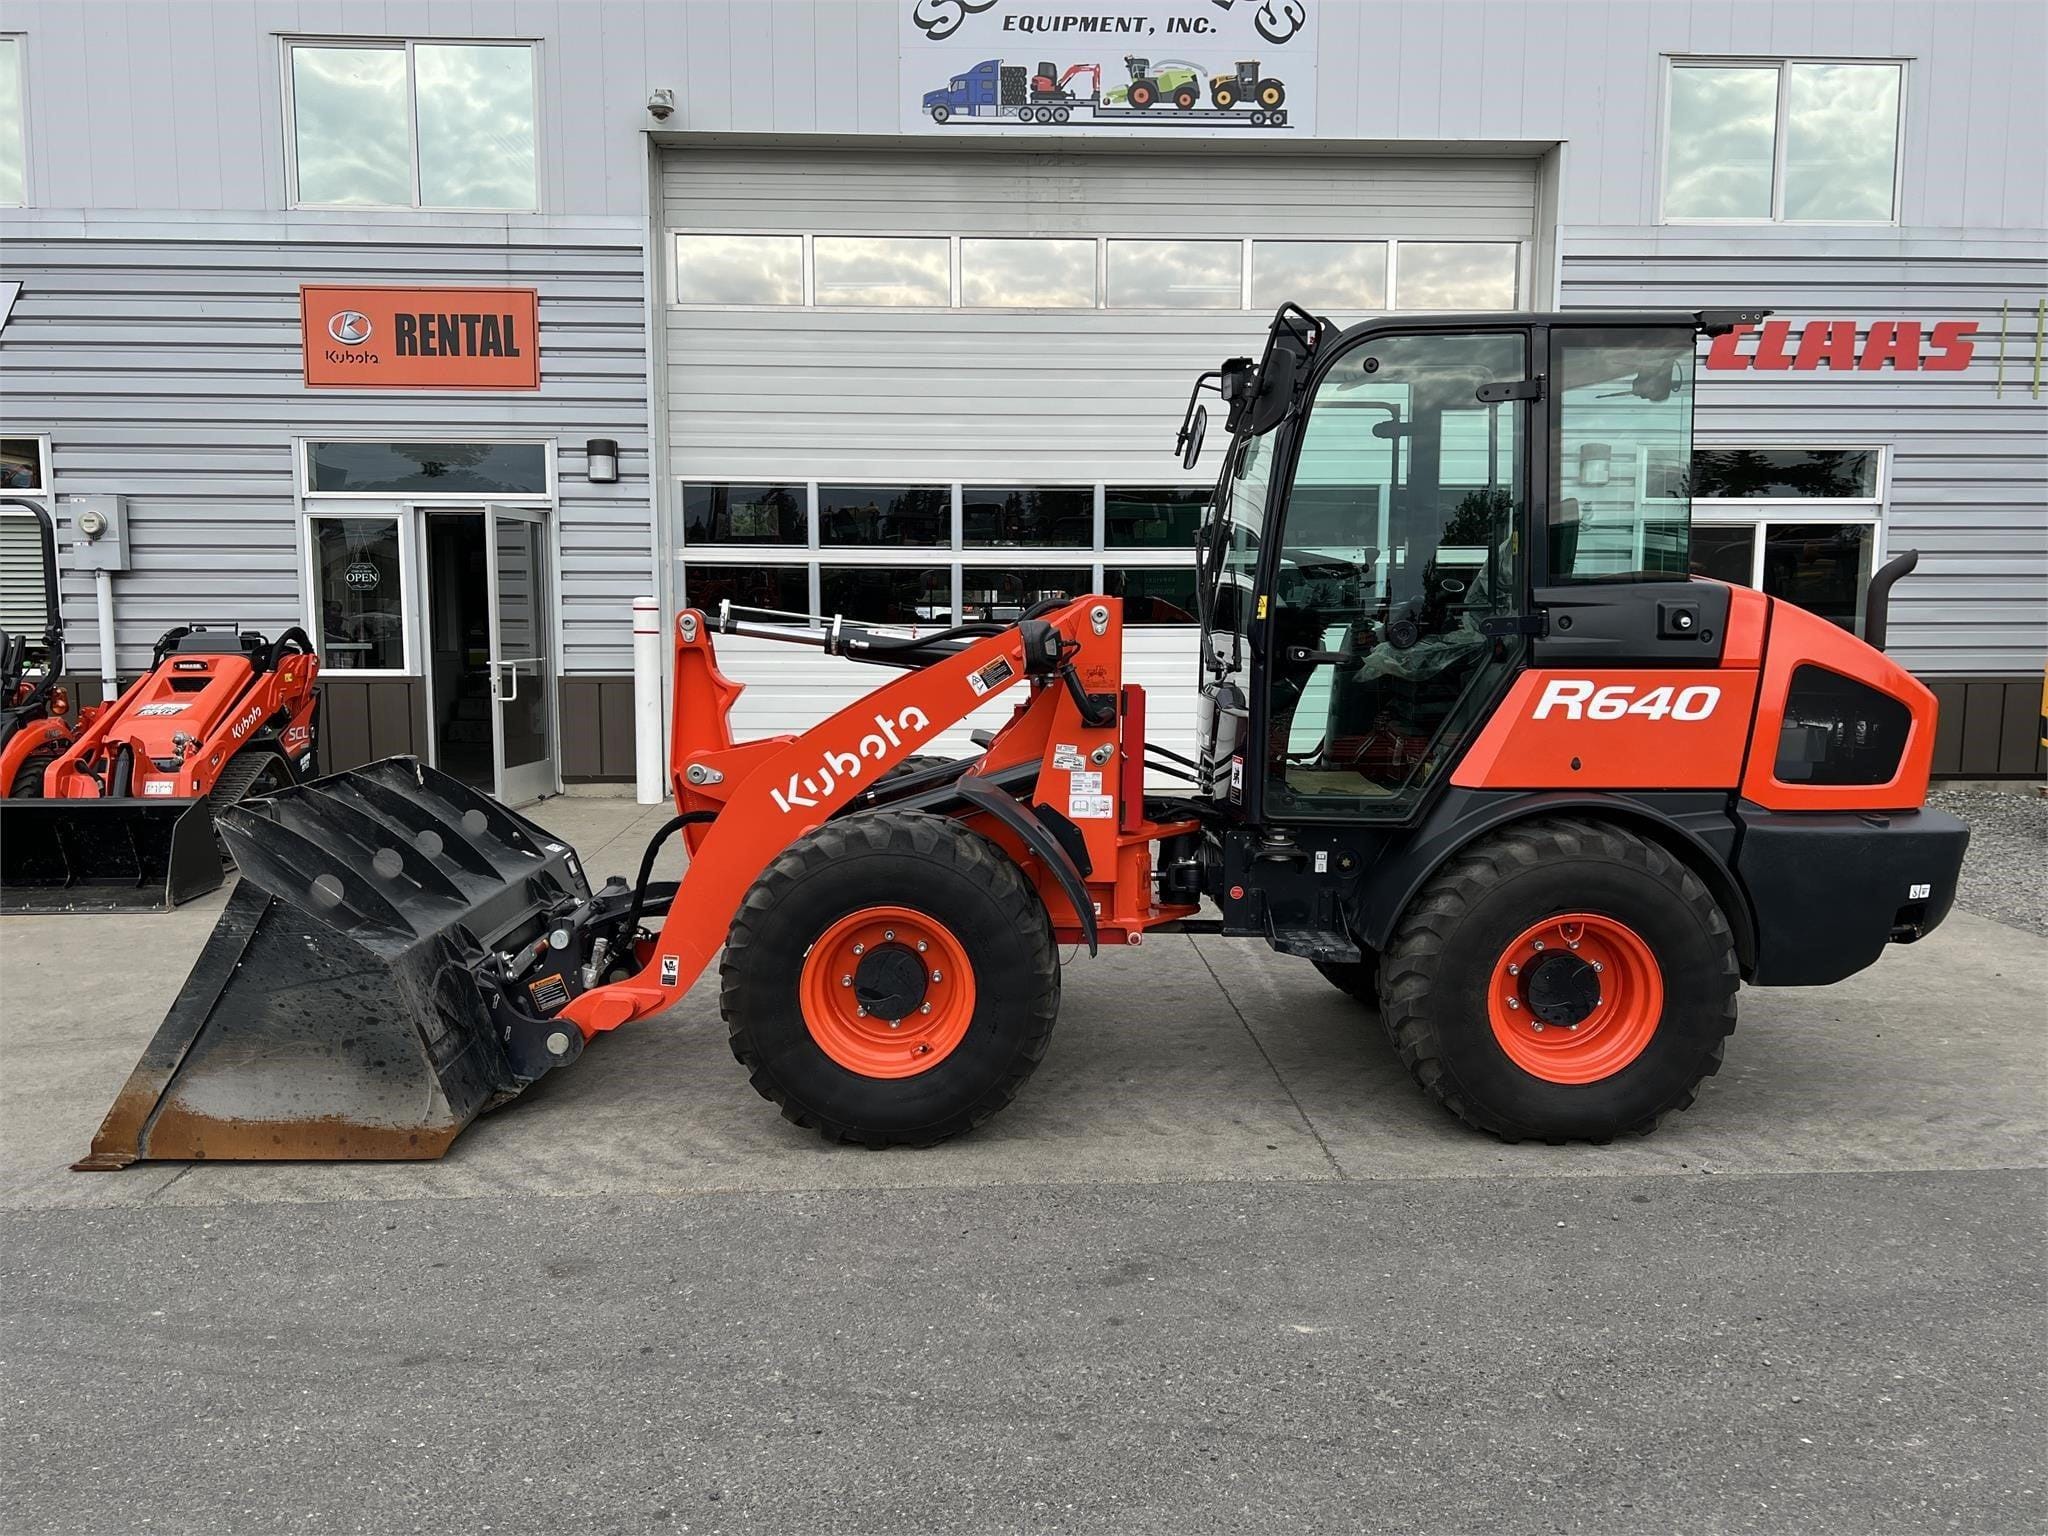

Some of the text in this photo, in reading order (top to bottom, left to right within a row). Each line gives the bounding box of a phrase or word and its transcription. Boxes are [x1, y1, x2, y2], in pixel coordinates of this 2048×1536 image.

[1003, 15, 1155, 36] EQUIPMENT,
[1166, 17, 1217, 34] INC.
[395, 313, 520, 357] RENTAL
[1706, 321, 1979, 371] CLAAS
[325, 350, 380, 364] Kubota
[346, 573, 378, 582] OPEN
[1532, 679, 1722, 721] R640
[231, 706, 262, 739] Kubota
[770, 706, 930, 813] Kubota
